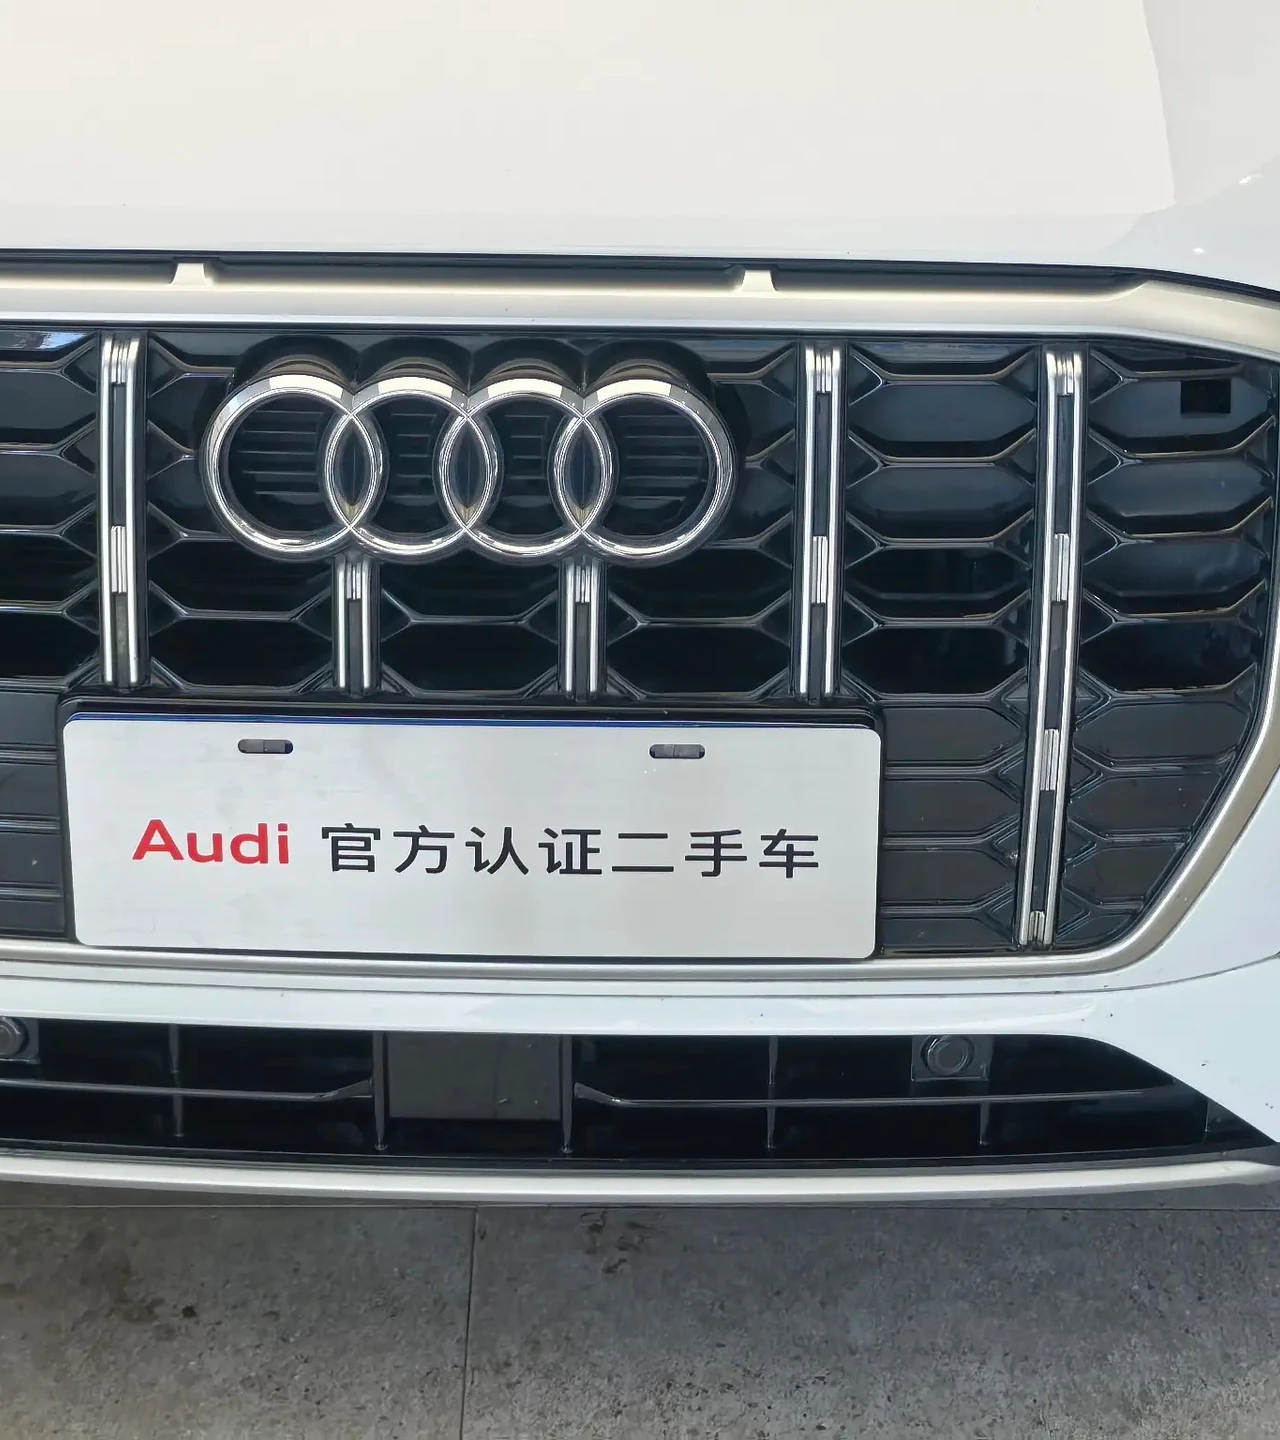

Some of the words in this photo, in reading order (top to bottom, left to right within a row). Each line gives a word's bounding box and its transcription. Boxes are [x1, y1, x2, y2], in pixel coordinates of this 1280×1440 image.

[132, 819, 290, 864] Audi
[320, 822, 820, 878] 官方认证二手车
